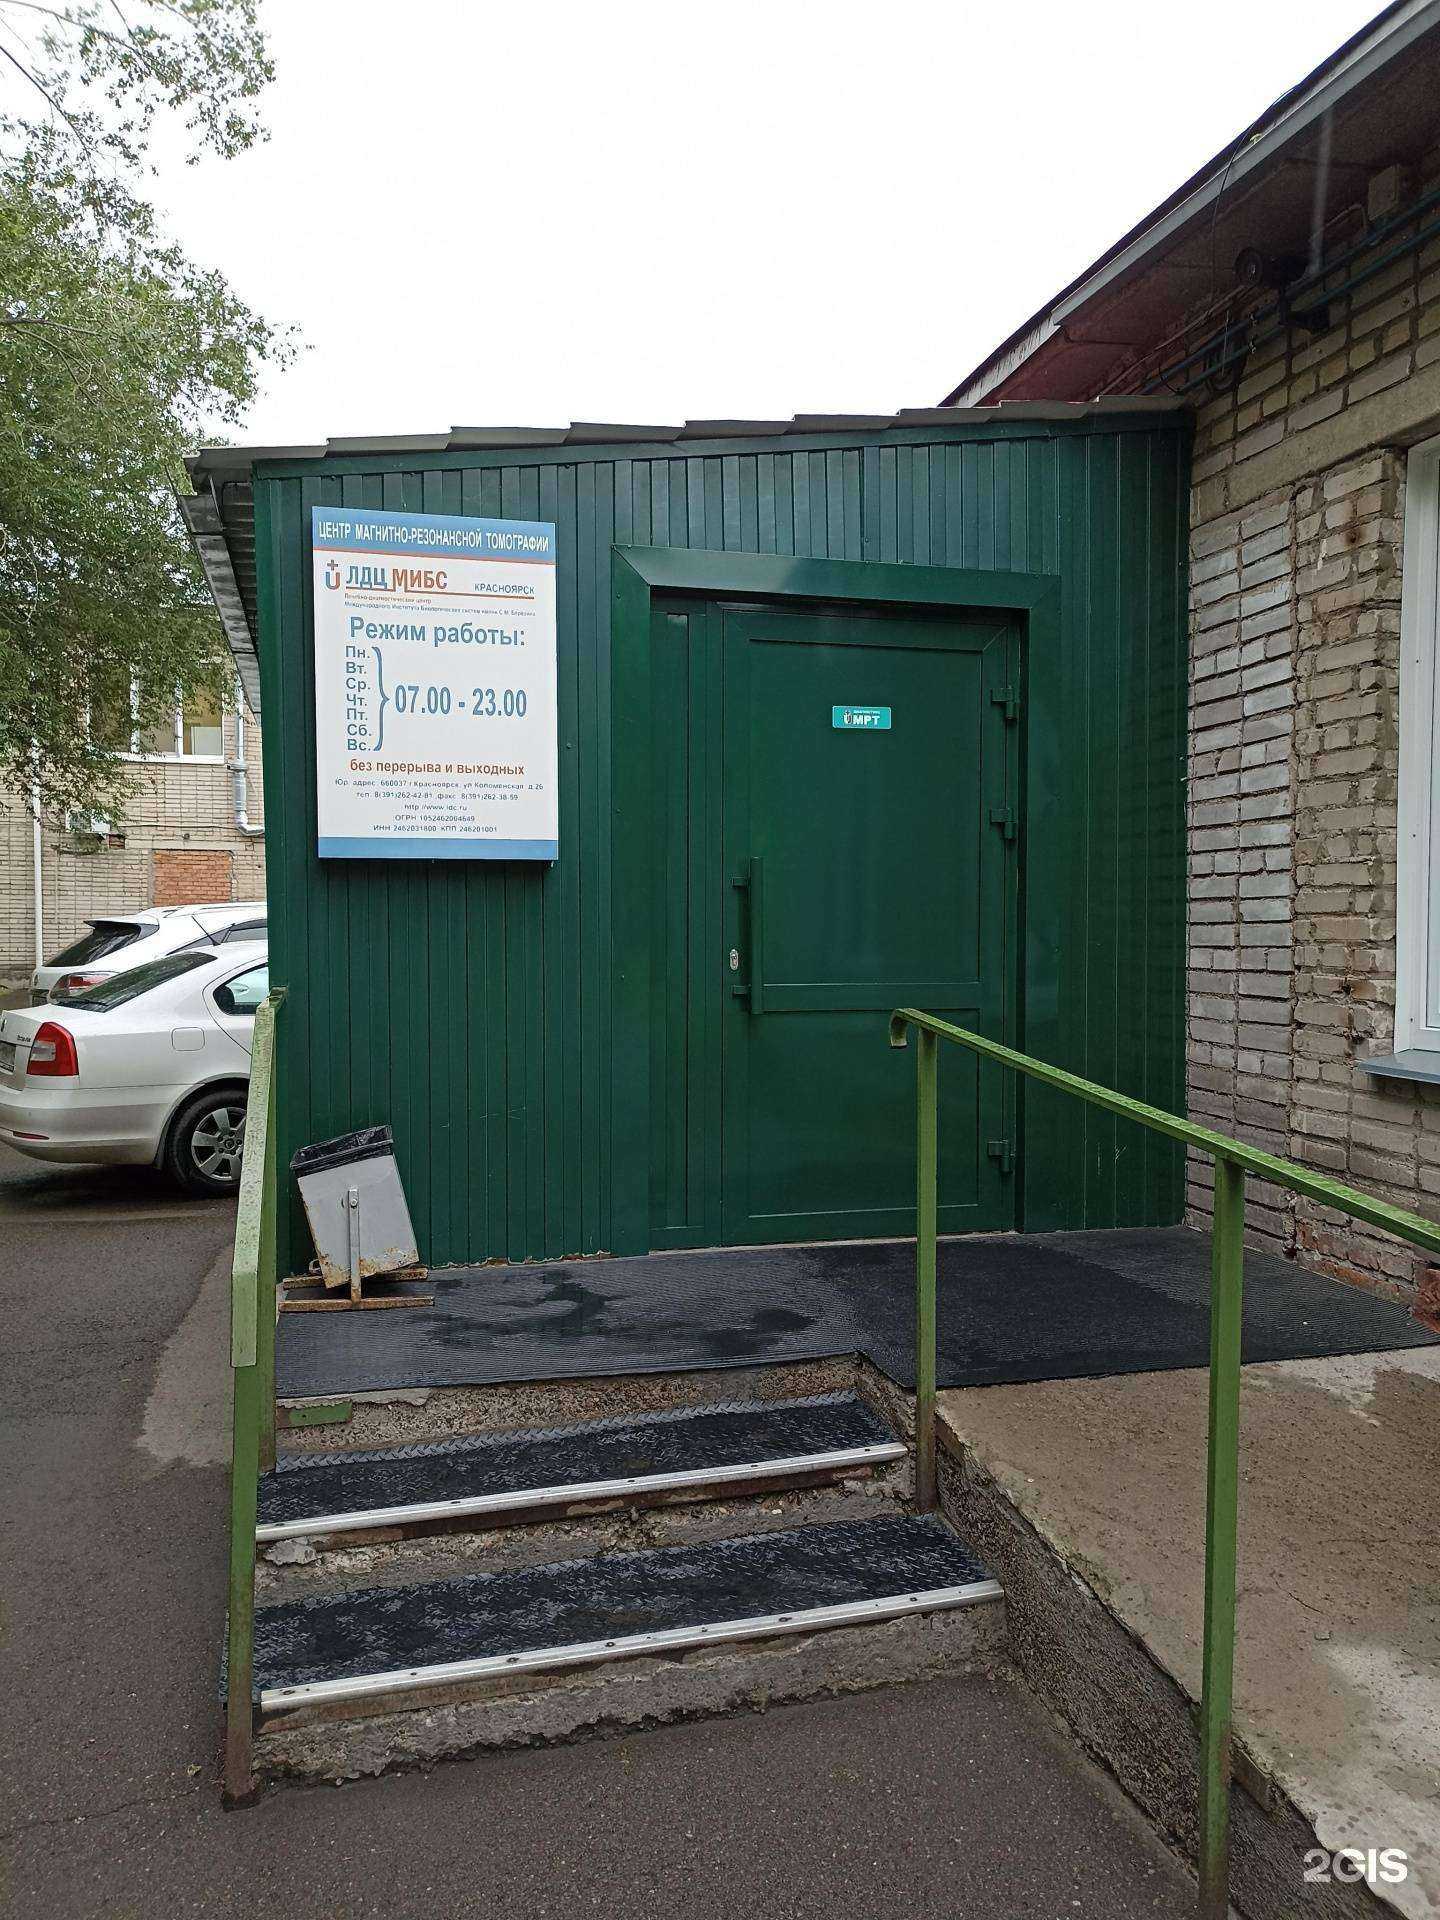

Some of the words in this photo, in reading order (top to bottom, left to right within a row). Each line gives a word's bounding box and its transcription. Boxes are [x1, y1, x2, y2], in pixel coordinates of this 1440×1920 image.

[319, 521, 351, 539] ЦЕНТР
[355, 524, 482, 548] МАГНИТНО-РЕЗОНАНСНОЙ
[486, 532, 549, 552] ТОМОГРАФИИ
[346, 565, 388, 589] ЛДЦ
[392, 568, 448, 591] МИБС
[474, 583, 535, 595] КРАСНОЯРСК
[350, 616, 426, 642] Режим
[434, 622, 526, 648] работы:
[346, 645, 370, 659] Пн.
[346, 661, 367, 674] Вт.
[346, 677, 371, 692] Ср.
[346, 694, 367, 706] Чт.
[395, 684, 451, 715] 07.00
[472, 687, 527, 717] 23.00
[347, 708, 368, 721] Пт.
[852, 715, 880, 726] МРТ
[347, 723, 372, 736] Сб.
[347, 739, 371, 751] Вс.
[350, 759, 372, 772] без
[376, 762, 441, 775] перерыва
[446, 764, 453, 774] и
[457, 764, 525, 776] выходных
